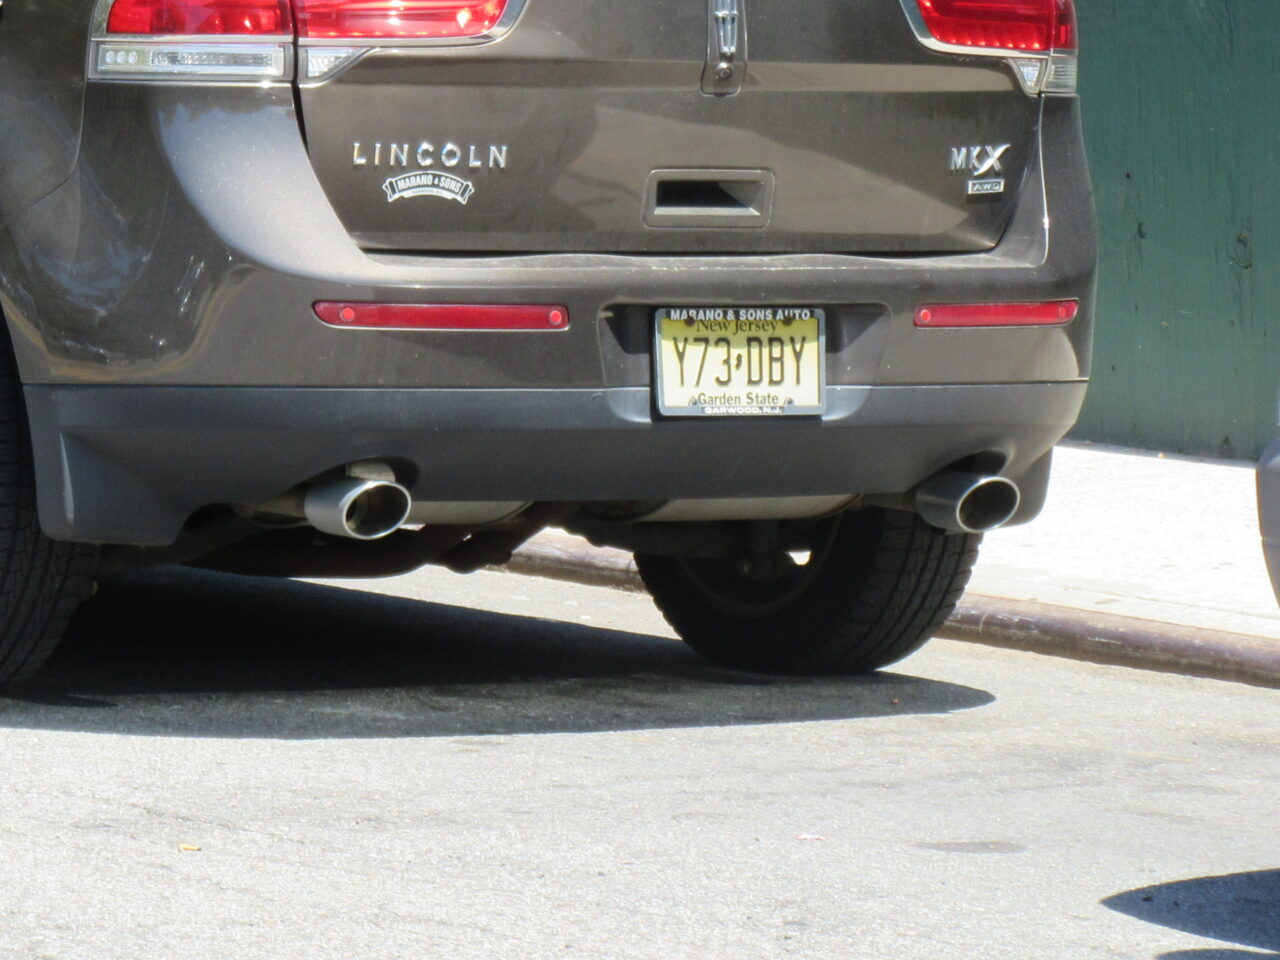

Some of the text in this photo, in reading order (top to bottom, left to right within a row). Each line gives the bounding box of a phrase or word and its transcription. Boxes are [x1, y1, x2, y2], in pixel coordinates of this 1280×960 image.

[353, 142, 507, 168] LINCOLN
[950, 144, 1011, 176] MKX
[397, 174, 433, 190] MARANO
[439, 176, 462, 193] SONS
[670, 309, 811, 321] MARANO & SONS AUTO
[696, 318, 778, 335] New Jersey
[698, 392, 779, 406] Garden State
